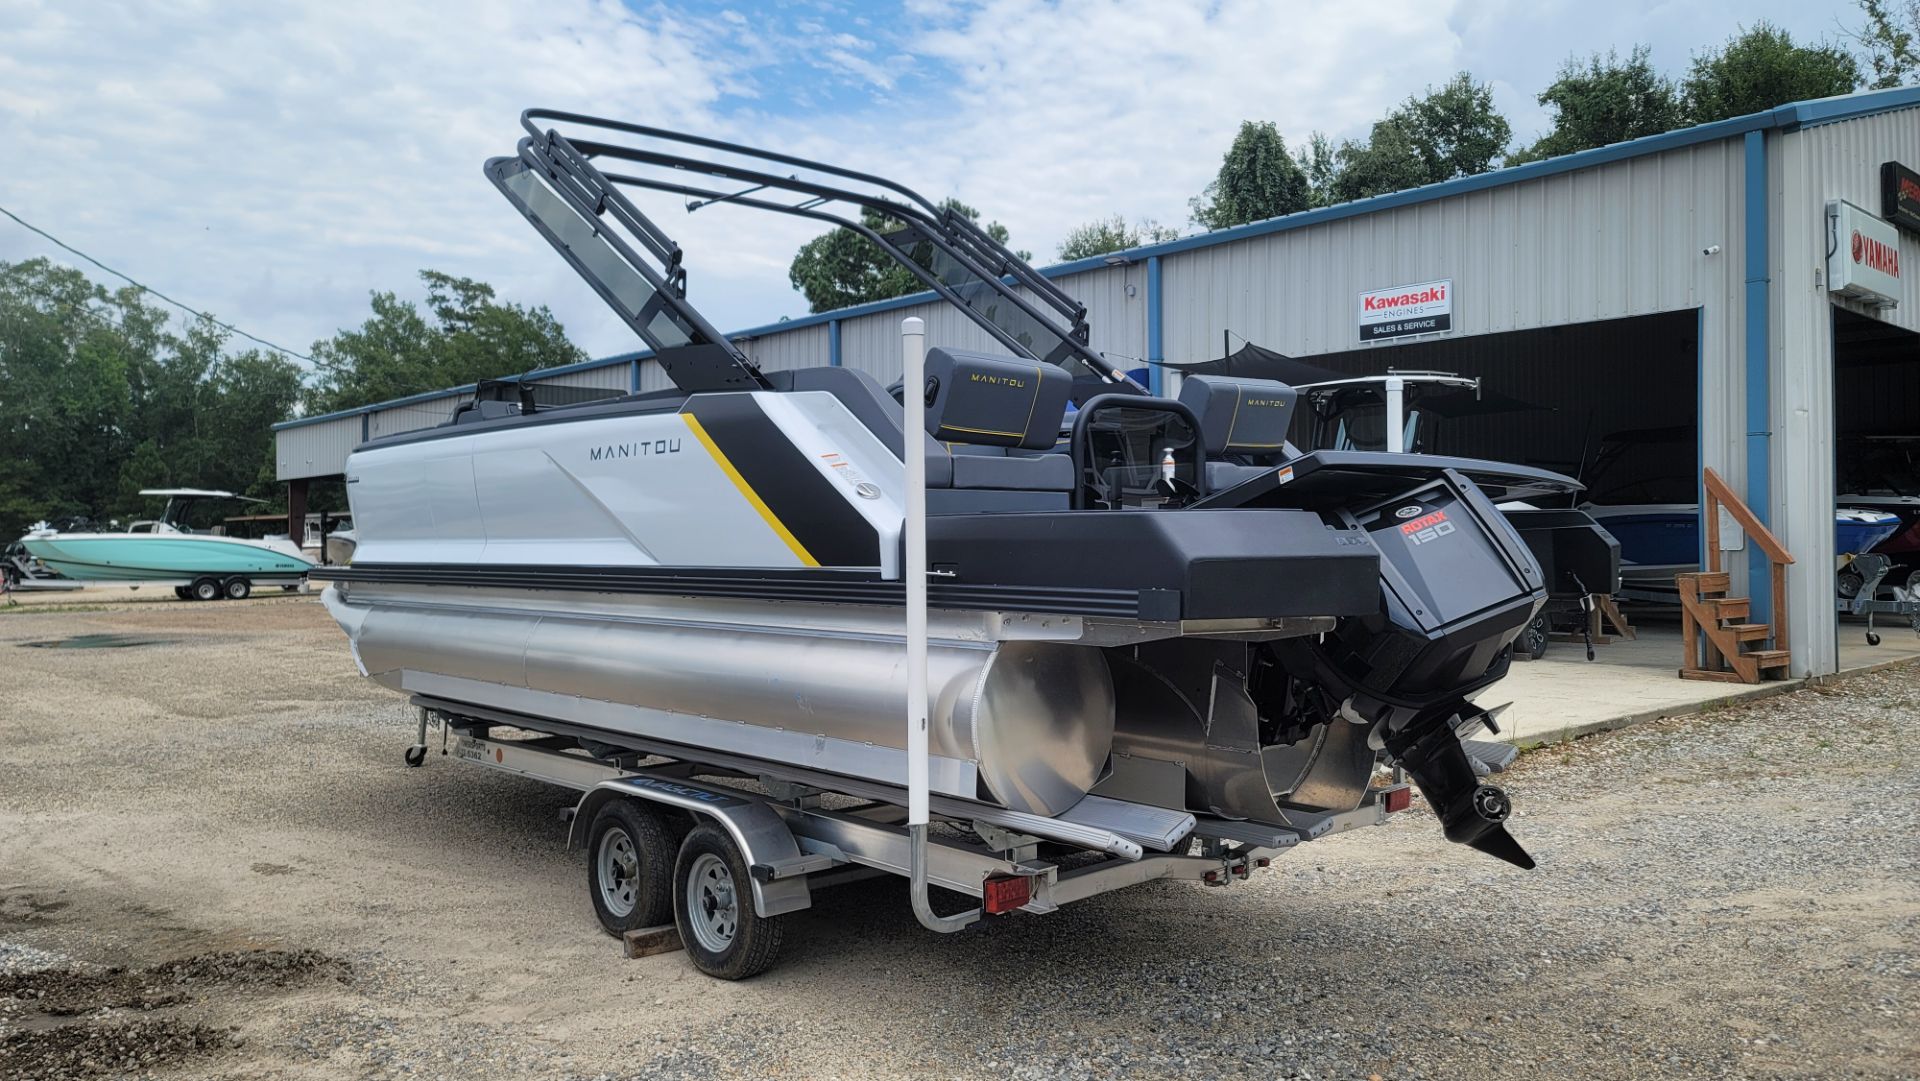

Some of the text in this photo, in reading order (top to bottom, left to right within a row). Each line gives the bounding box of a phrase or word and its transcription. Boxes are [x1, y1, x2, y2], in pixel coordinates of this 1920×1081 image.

[1863, 235, 1899, 279] YAMAHA
[1364, 286, 1445, 311] Kawasaki
[1383, 306, 1424, 319] ENGINES
[1373, 320, 1436, 335] SALES & SERVICE
[970, 373, 1025, 388] MANITOU
[1247, 399, 1286, 407] MANITOU
[590, 438, 681, 461] MANITOU
[1401, 511, 1448, 535] ROTAX
[1408, 520, 1456, 545] 150
